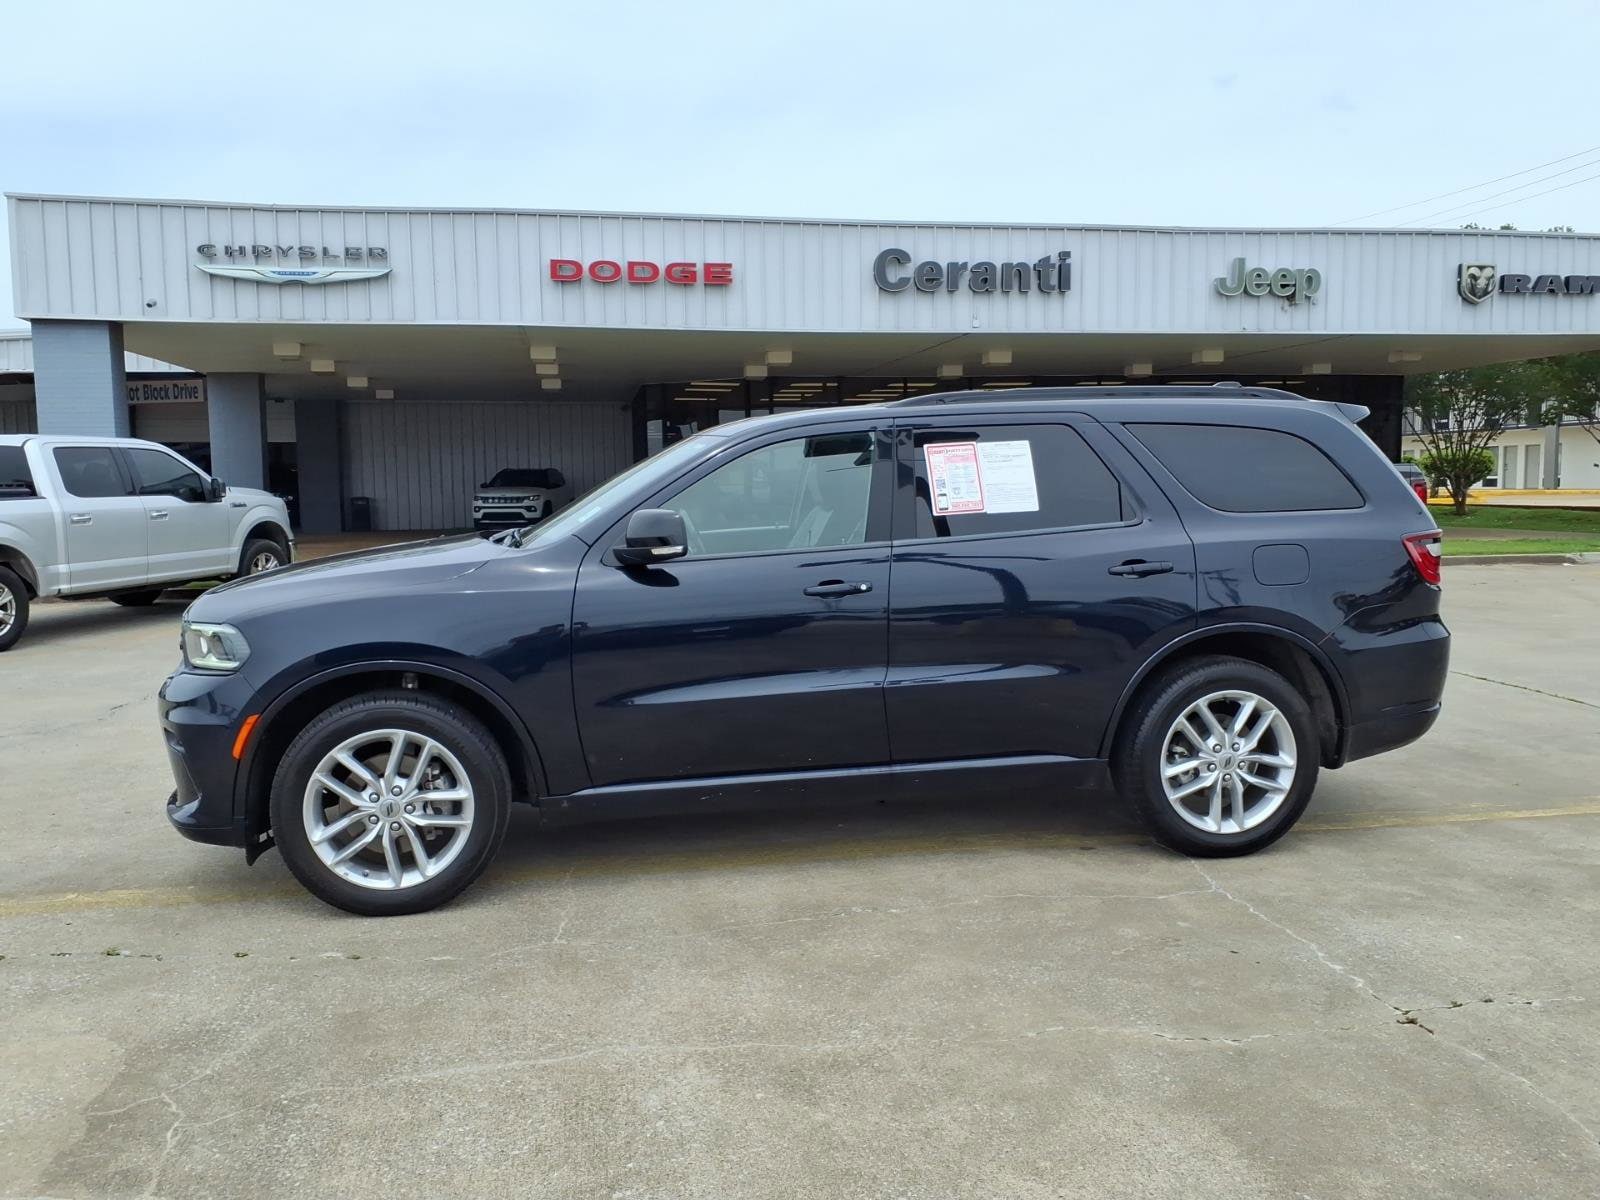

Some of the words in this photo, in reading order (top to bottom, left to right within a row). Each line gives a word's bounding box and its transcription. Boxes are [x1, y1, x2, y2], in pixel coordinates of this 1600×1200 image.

[196, 244, 388, 259] CHRYSLER
[550, 259, 733, 286] DODGE
[873, 248, 1072, 292] Ceranti
[1213, 257, 1321, 304] Jeep
[1499, 274, 1600, 294] RAM
[127, 385, 140, 401] ot
[142, 384, 170, 401] Block
[173, 384, 199, 400] Drive
